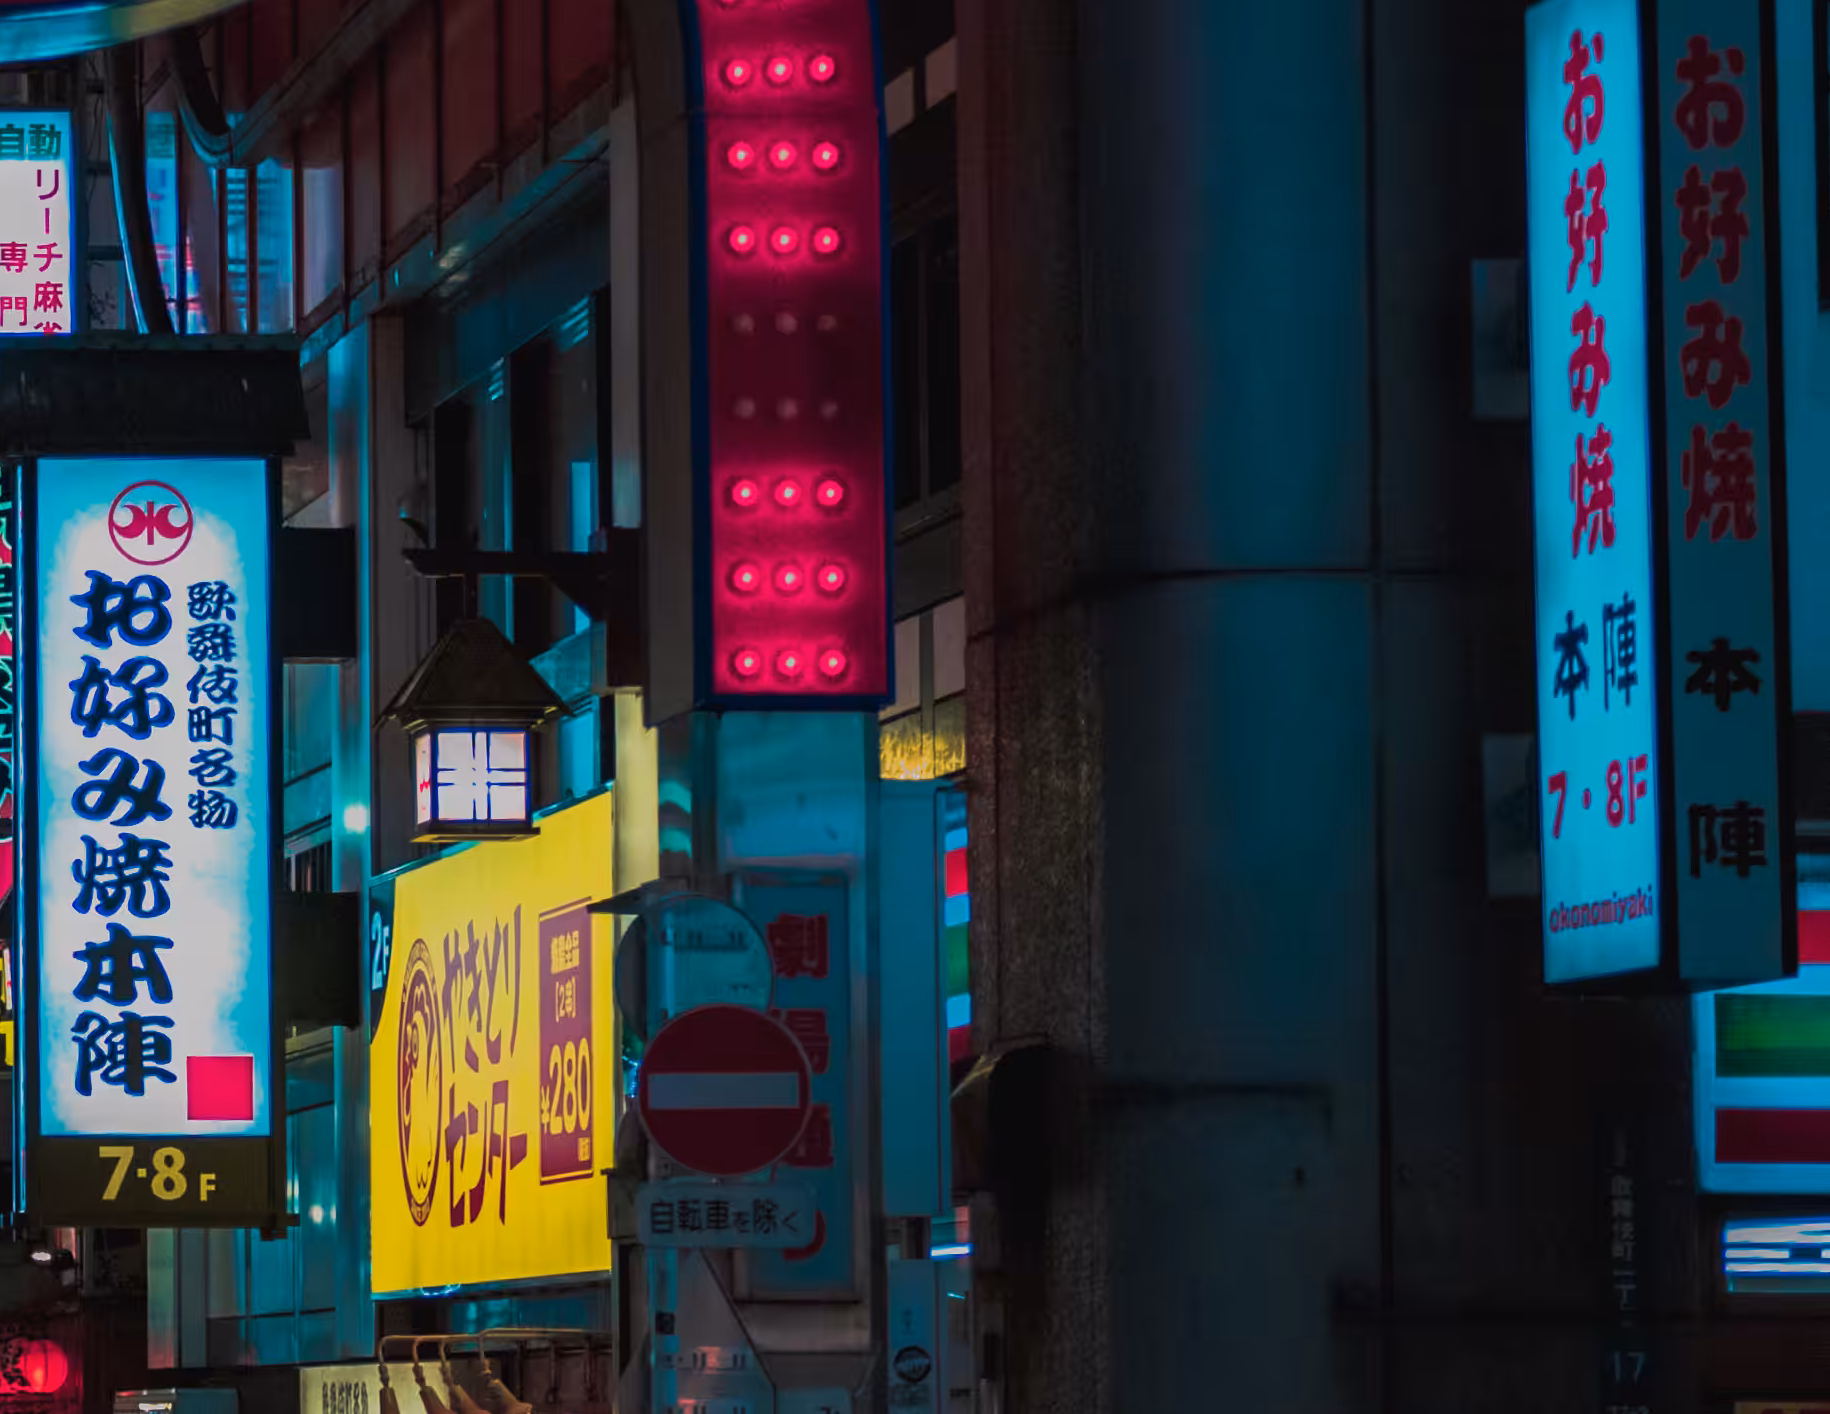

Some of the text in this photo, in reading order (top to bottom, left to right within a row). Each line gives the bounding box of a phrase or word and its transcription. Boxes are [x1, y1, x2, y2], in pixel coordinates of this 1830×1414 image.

[1563, 29, 1614, 558] お好み焼
[186, 579, 238, 829] 歌舞伎町名物
[1554, 592, 1638, 722] 本陣
[69, 569, 177, 1097] お好み焼本陣
[1549, 888, 1652, 932] okonomiyaki
[443, 903, 522, 1074] やきとり
[445, 1079, 528, 1228] センター
[540, 1036, 592, 1137] ¥280
[650, 1197, 800, 1238] 自転車を除く
